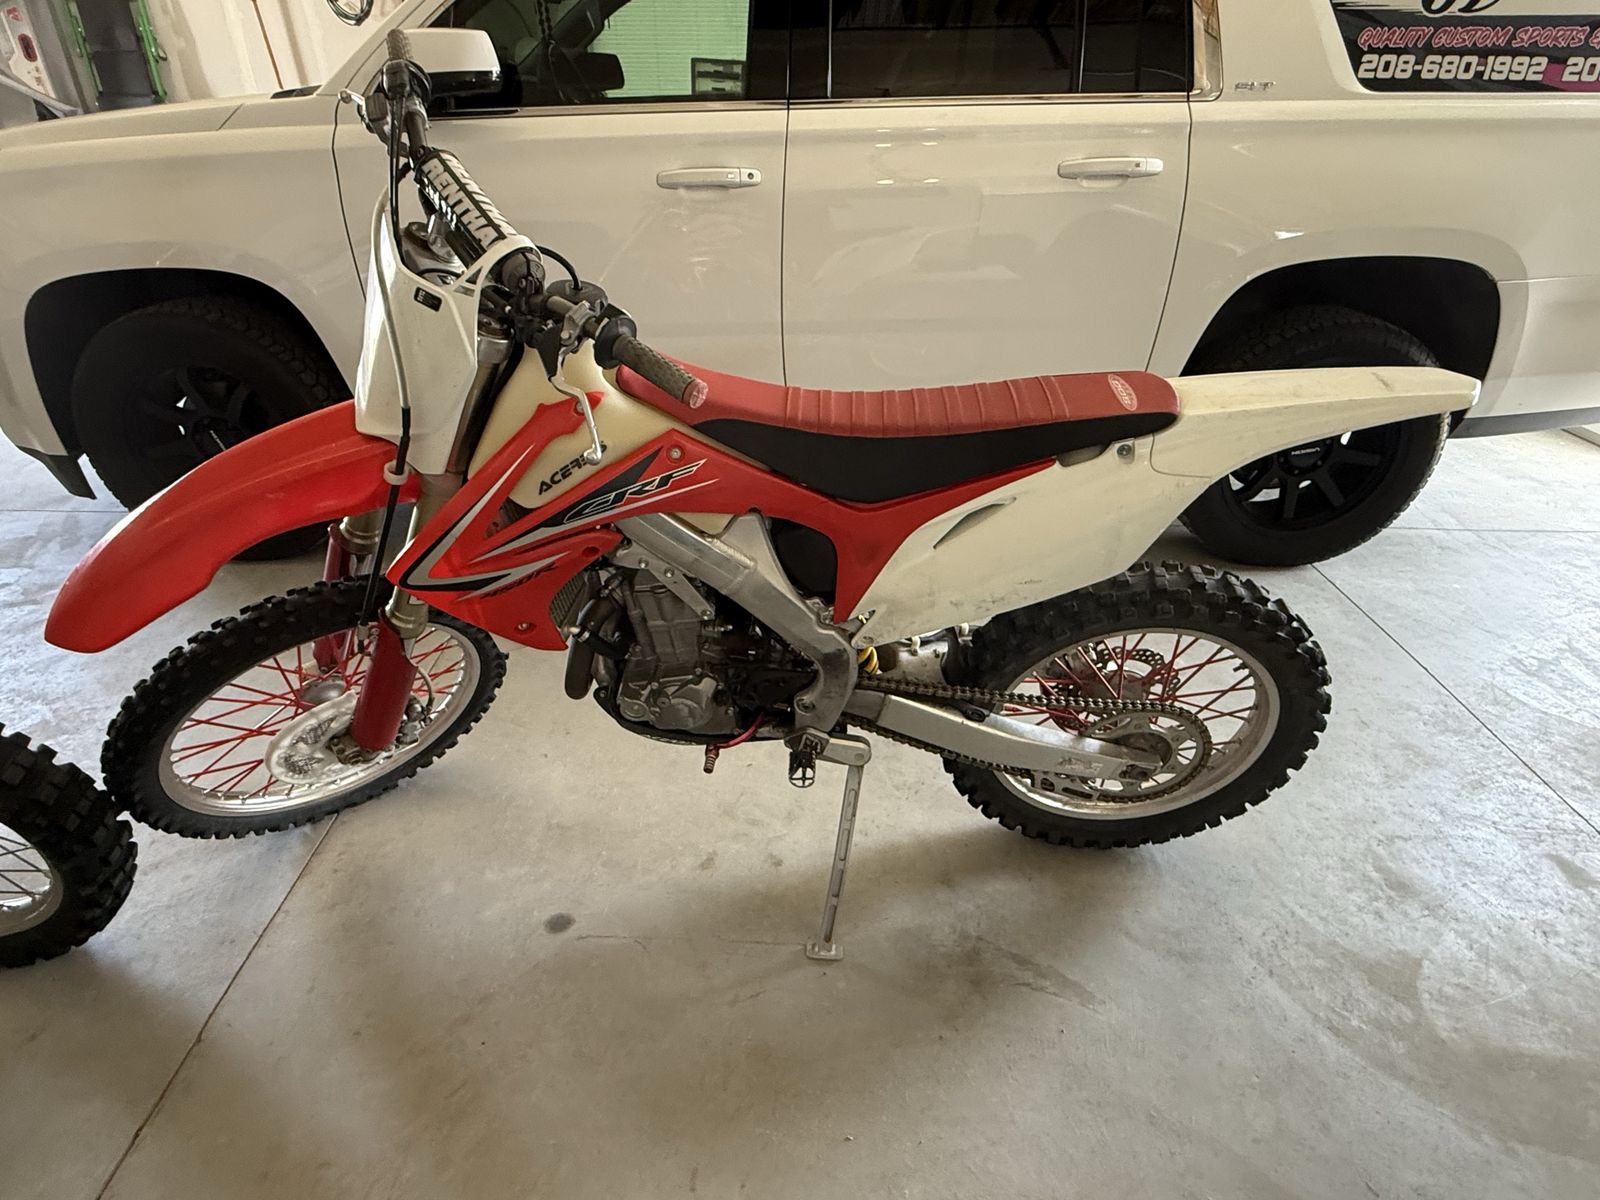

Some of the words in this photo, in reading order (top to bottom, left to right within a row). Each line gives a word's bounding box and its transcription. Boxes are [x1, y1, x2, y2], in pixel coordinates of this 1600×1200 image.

[1358, 26, 1434, 51] QUALITY
[1432, 26, 1513, 48] CUSTOM
[1512, 26, 1590, 47] SPORTS
[1357, 54, 1548, 81] 208-680-1992
[421, 157, 501, 250] RENTHA
[538, 441, 607, 496] ACER
[563, 458, 708, 524] CRF
